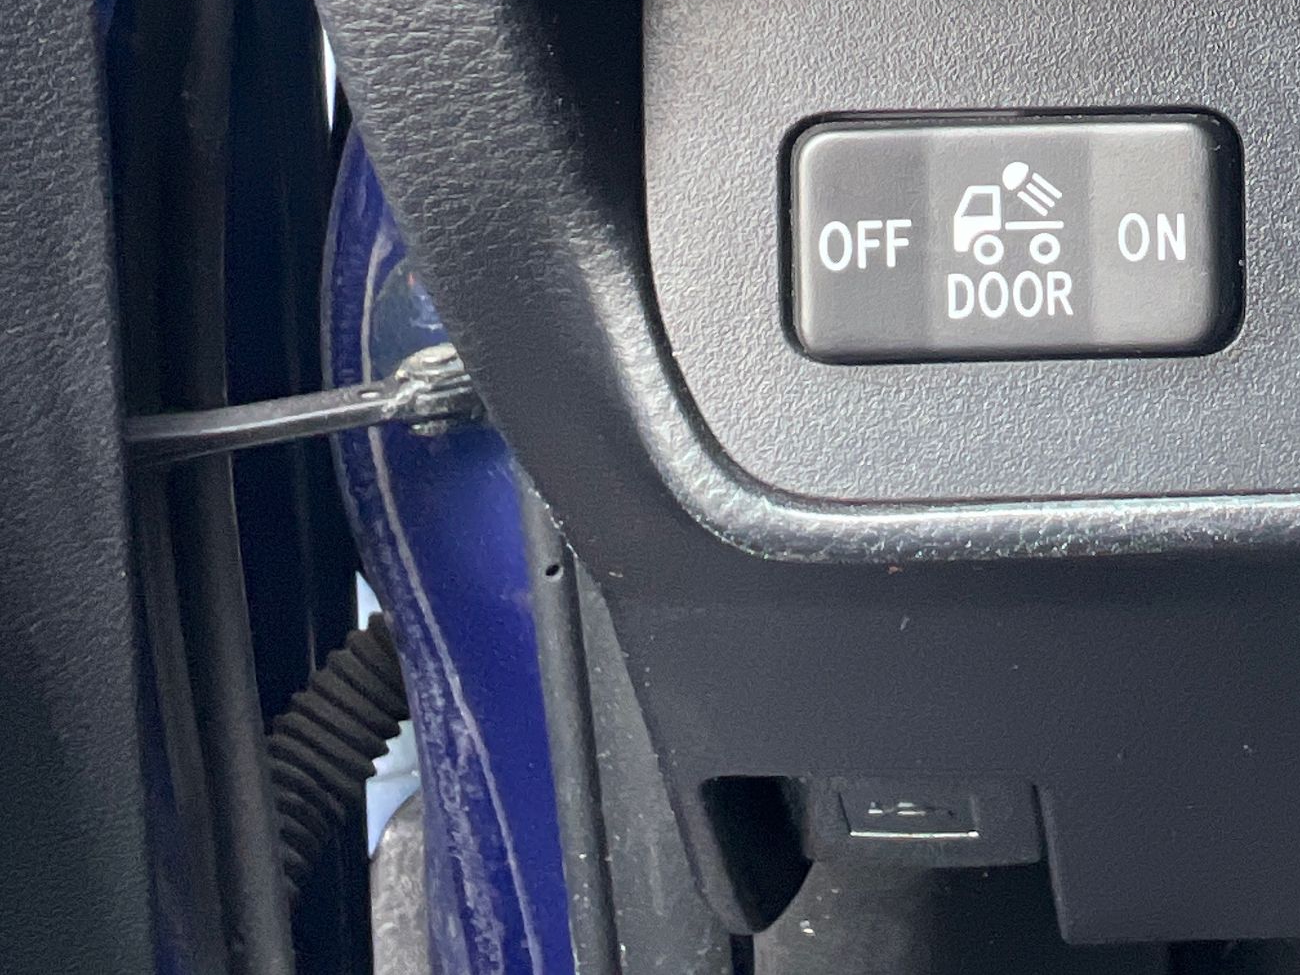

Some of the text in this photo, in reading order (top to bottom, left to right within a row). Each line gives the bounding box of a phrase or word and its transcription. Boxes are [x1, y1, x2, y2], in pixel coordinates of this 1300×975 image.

[818, 218, 913, 272] OFF
[1117, 212, 1187, 262] ON
[946, 270, 1074, 320] DOOR
